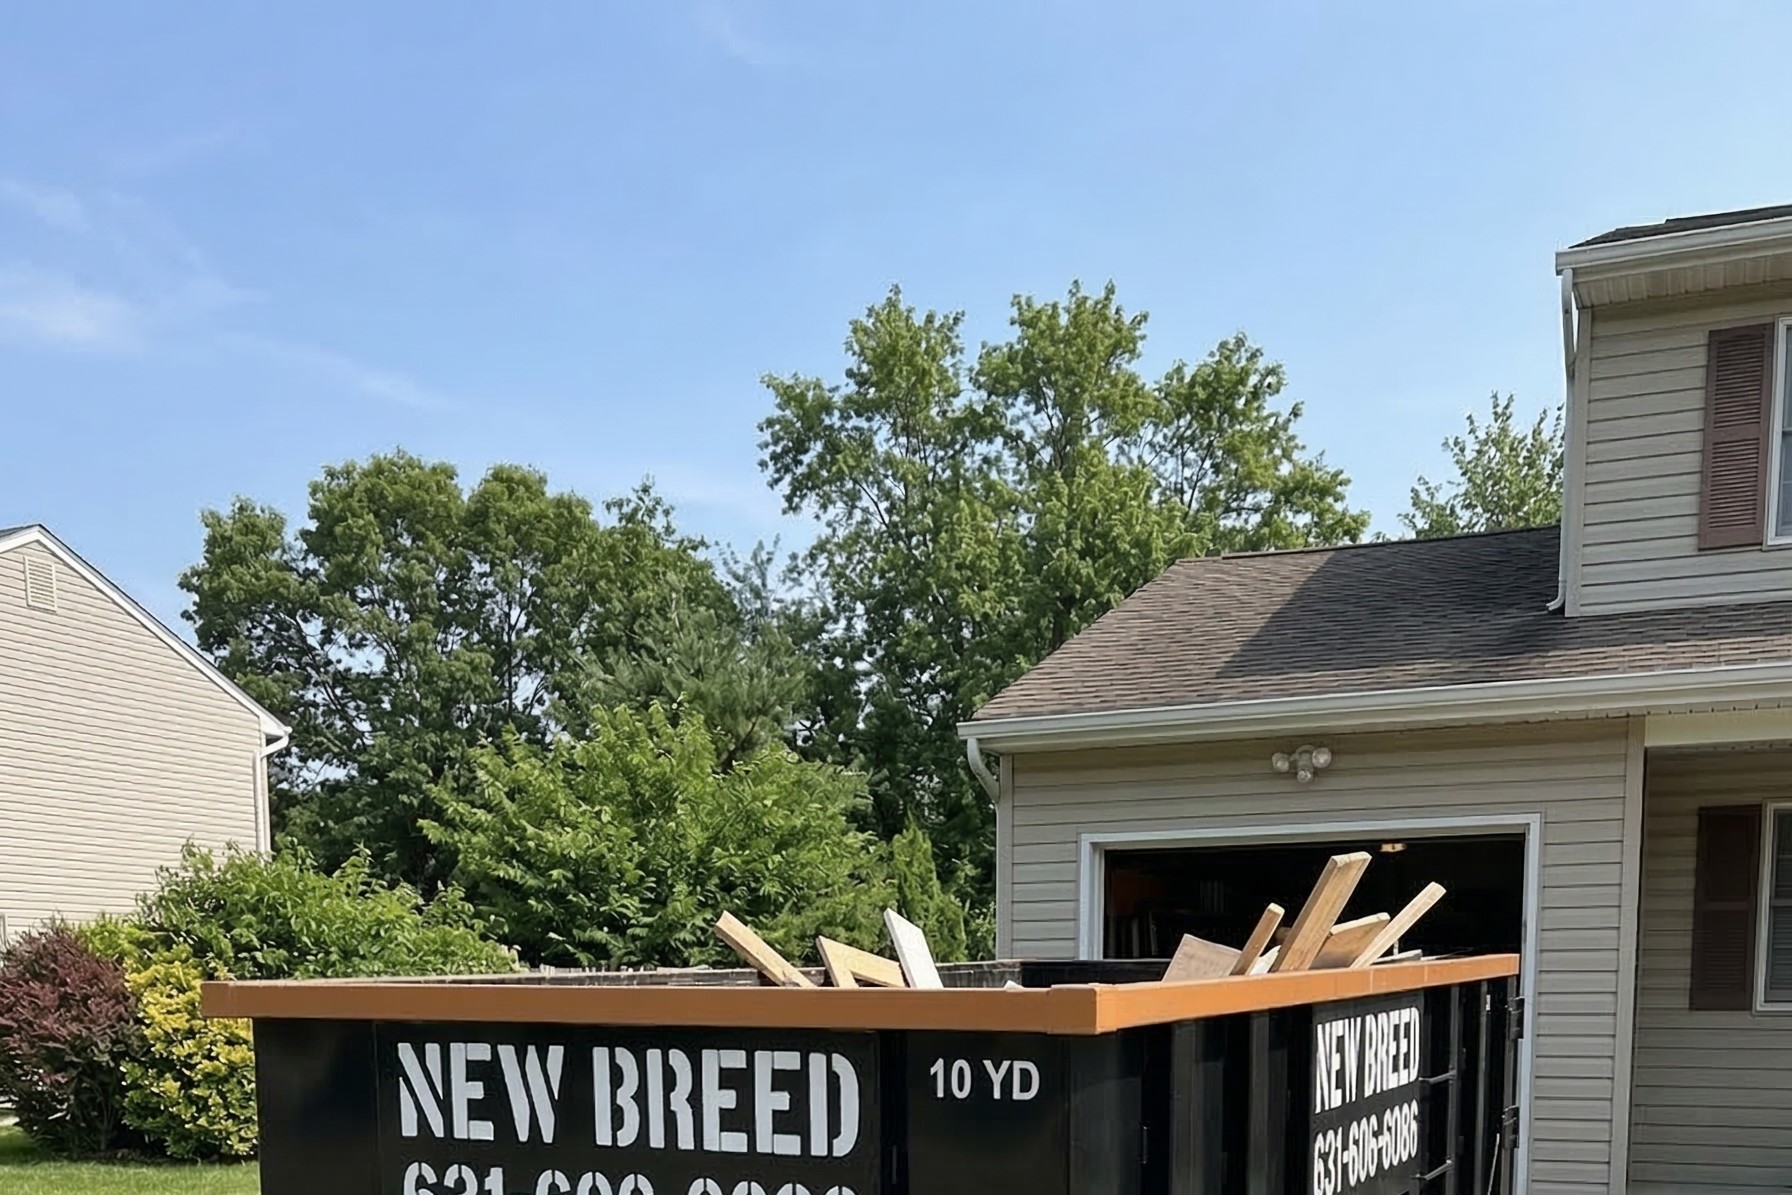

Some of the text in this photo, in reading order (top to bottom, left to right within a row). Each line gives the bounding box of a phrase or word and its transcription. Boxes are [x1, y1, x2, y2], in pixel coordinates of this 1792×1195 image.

[397, 1042, 860, 1157] NEW BREED
[929, 1058, 1040, 1101] 10 YD
[1315, 1006, 1420, 1114] NEW BREED
